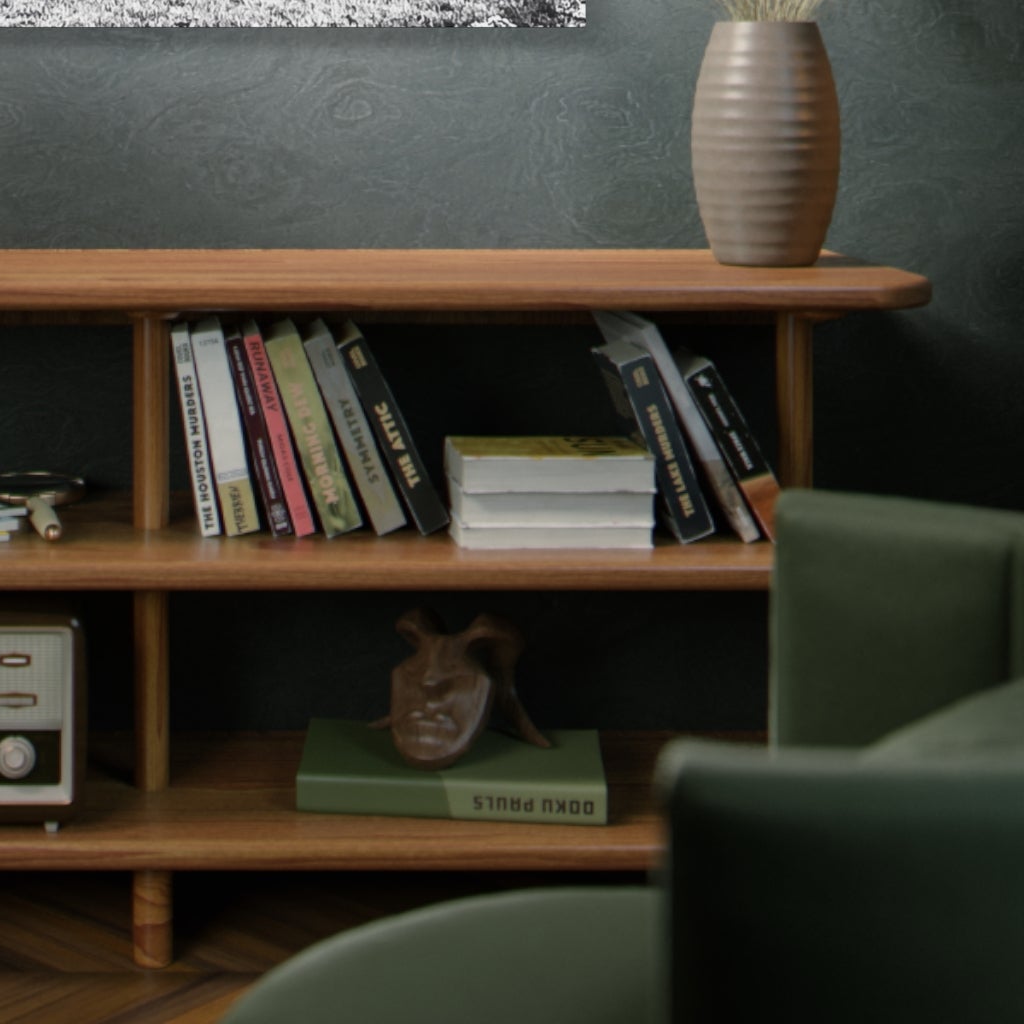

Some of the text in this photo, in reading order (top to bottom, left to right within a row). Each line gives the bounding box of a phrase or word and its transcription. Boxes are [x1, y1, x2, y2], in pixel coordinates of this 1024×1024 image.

[182, 375, 200, 436] MURDERS
[249, 340, 277, 412] RUNAWAY
[288, 382, 312, 419] DEW
[338, 398, 380, 484] SYMMETRY
[374, 401, 422, 489] THE ATTIC
[645, 403, 675, 461] MURDERS
[192, 439, 210, 503] HOUSTON
[303, 422, 339, 505] MORNING
[201, 505, 214, 530] THE
[678, 492, 695, 519] THE
[472, 794, 595, 816] DOKU PAULS
